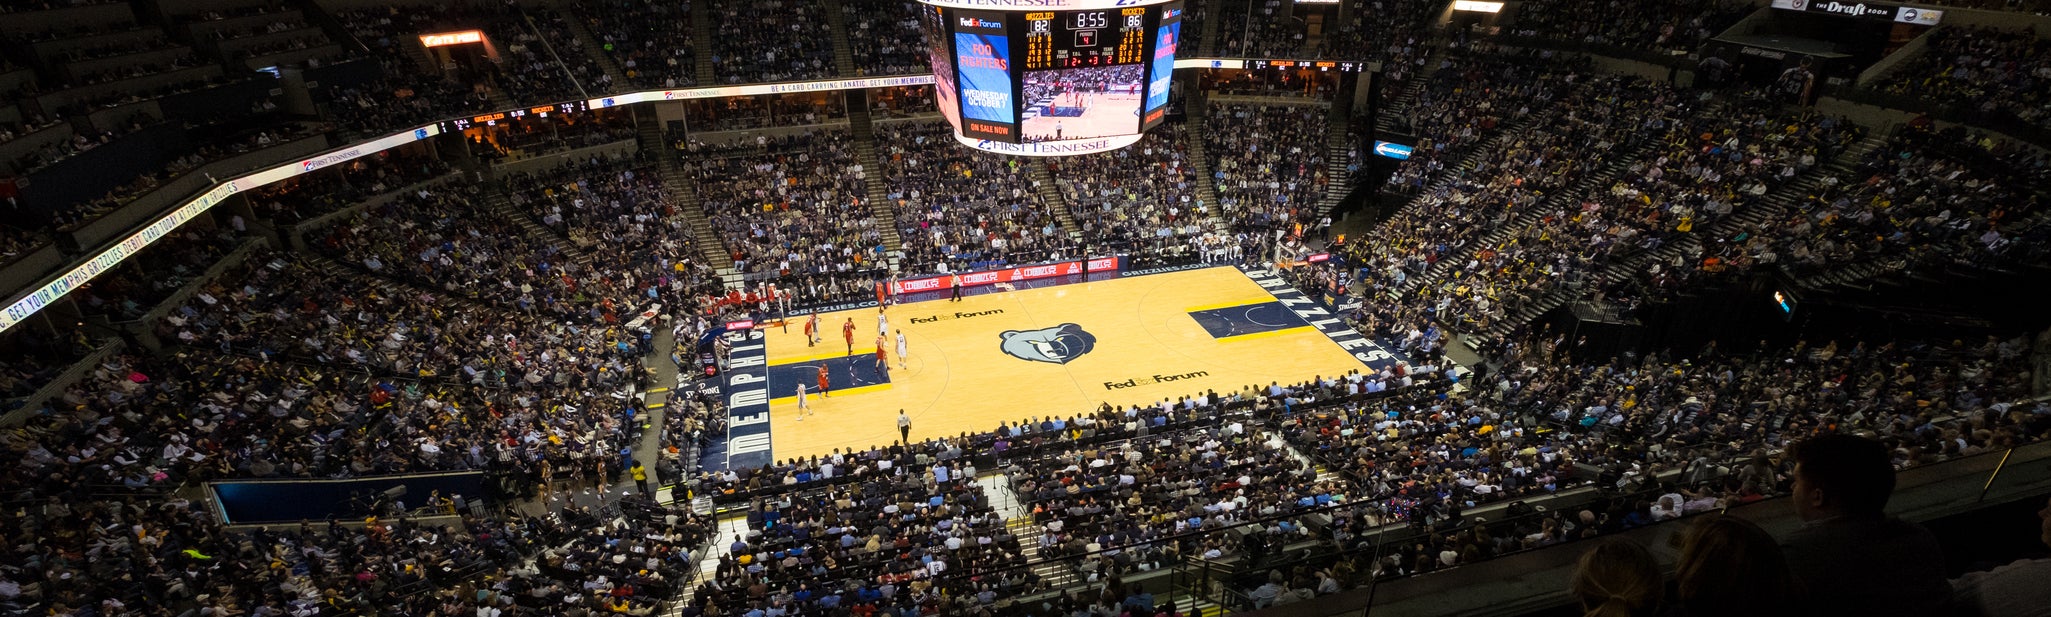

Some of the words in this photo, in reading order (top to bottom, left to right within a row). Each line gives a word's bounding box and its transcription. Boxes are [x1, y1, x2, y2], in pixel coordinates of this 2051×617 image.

[1121, 7, 1146, 16] ROCKETS
[1827, 1, 1867, 16] Draft
[1026, 12, 1055, 20] GRIZZLIES
[1077, 12, 1106, 28] 8:55
[1128, 15, 1141, 27] 86
[960, 17, 1002, 29] FedExForum
[1034, 20, 1049, 31] 82
[1083, 36, 1090, 45] 4
[972, 43, 992, 56] FOO
[960, 55, 1007, 70] FIGHTERS
[1071, 57, 1078, 67] 2
[1093, 56, 1099, 65] 3
[1107, 55, 1113, 64] 2
[901, 76, 929, 85] MEMPHIS
[963, 88, 1009, 102] WEDNESDAY
[968, 97, 1001, 109] OCTOBER
[1001, 100, 1006, 109] 7
[474, 113, 504, 122] GRIZZLIES
[970, 123, 979, 131] ON
[980, 124, 993, 133] SALE
[994, 126, 1009, 135] NOW
[993, 140, 1025, 152] FIRST
[1032, 139, 1110, 153] TENNESSEE
[311, 158, 328, 168] FIRST
[328, 149, 361, 164] TENNESSEE
[7, 302, 28, 322] GET
[26, 288, 52, 310] YOUR
[50, 267, 89, 297] MEMPHIS
[87, 248, 124, 276] GRIZZLIES
[122, 235, 143, 254] DEBIT
[142, 225, 161, 243] CARD
[159, 215, 179, 233] TODAY
[179, 209, 188, 220] AT
[1122, 262, 1211, 277] GRIZZLIES.COM
[1245, 268, 1391, 362] GRIZZLIES
